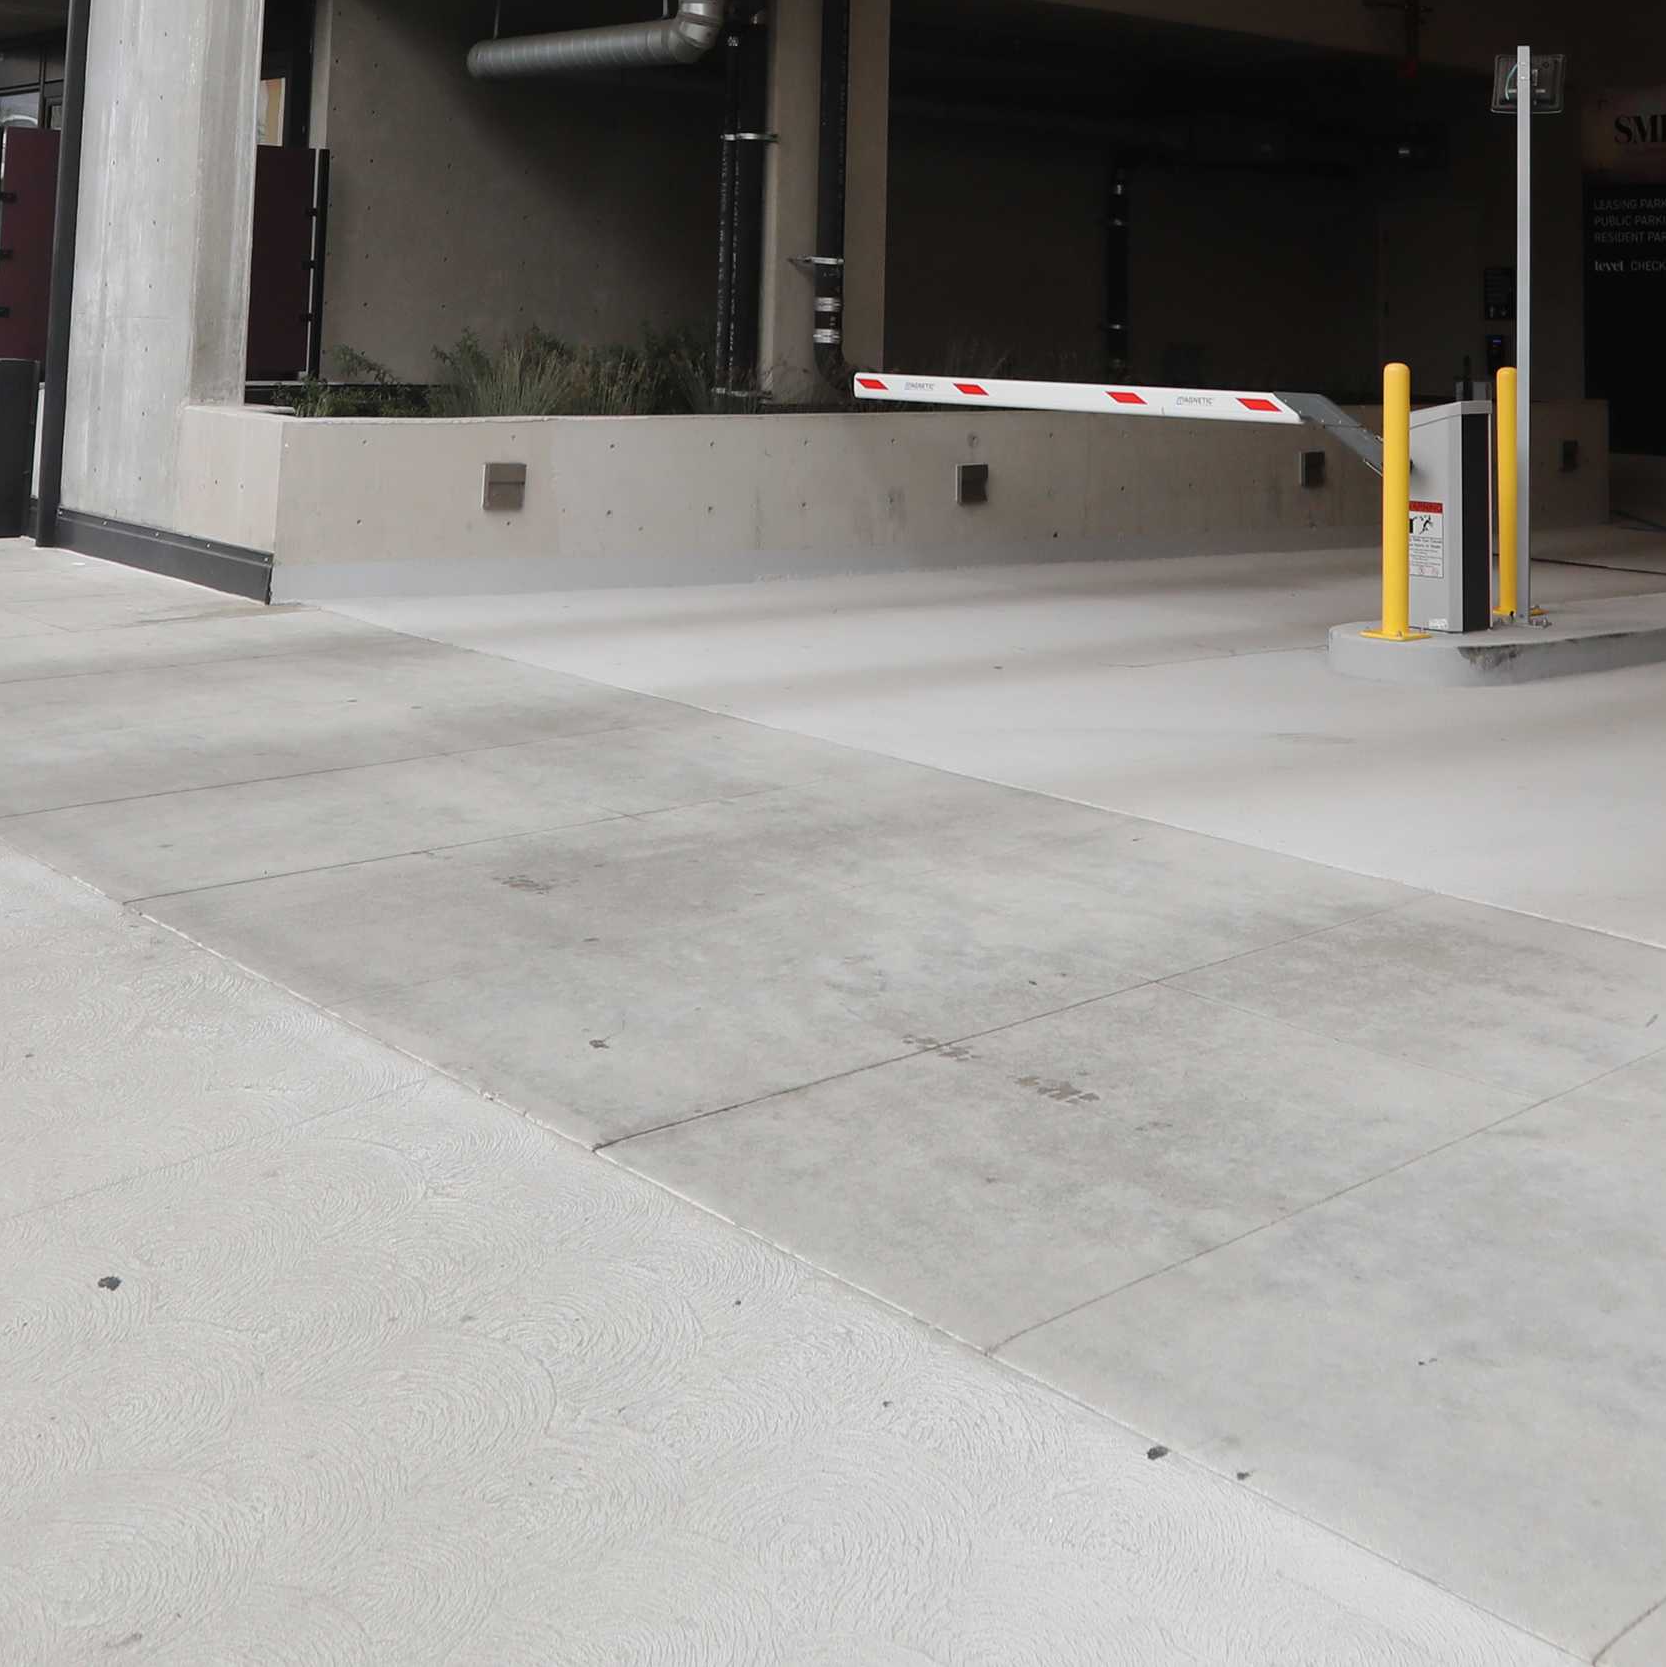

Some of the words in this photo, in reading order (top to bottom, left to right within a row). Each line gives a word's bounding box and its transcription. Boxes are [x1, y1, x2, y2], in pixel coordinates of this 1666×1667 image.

[1593, 198, 1637, 210] LEASING
[1594, 214, 1631, 226] PUBLIC
[1594, 231, 1644, 243] RESIDENT
[1594, 260, 1624, 271] level
[1630, 261, 1666, 271] CHECK
